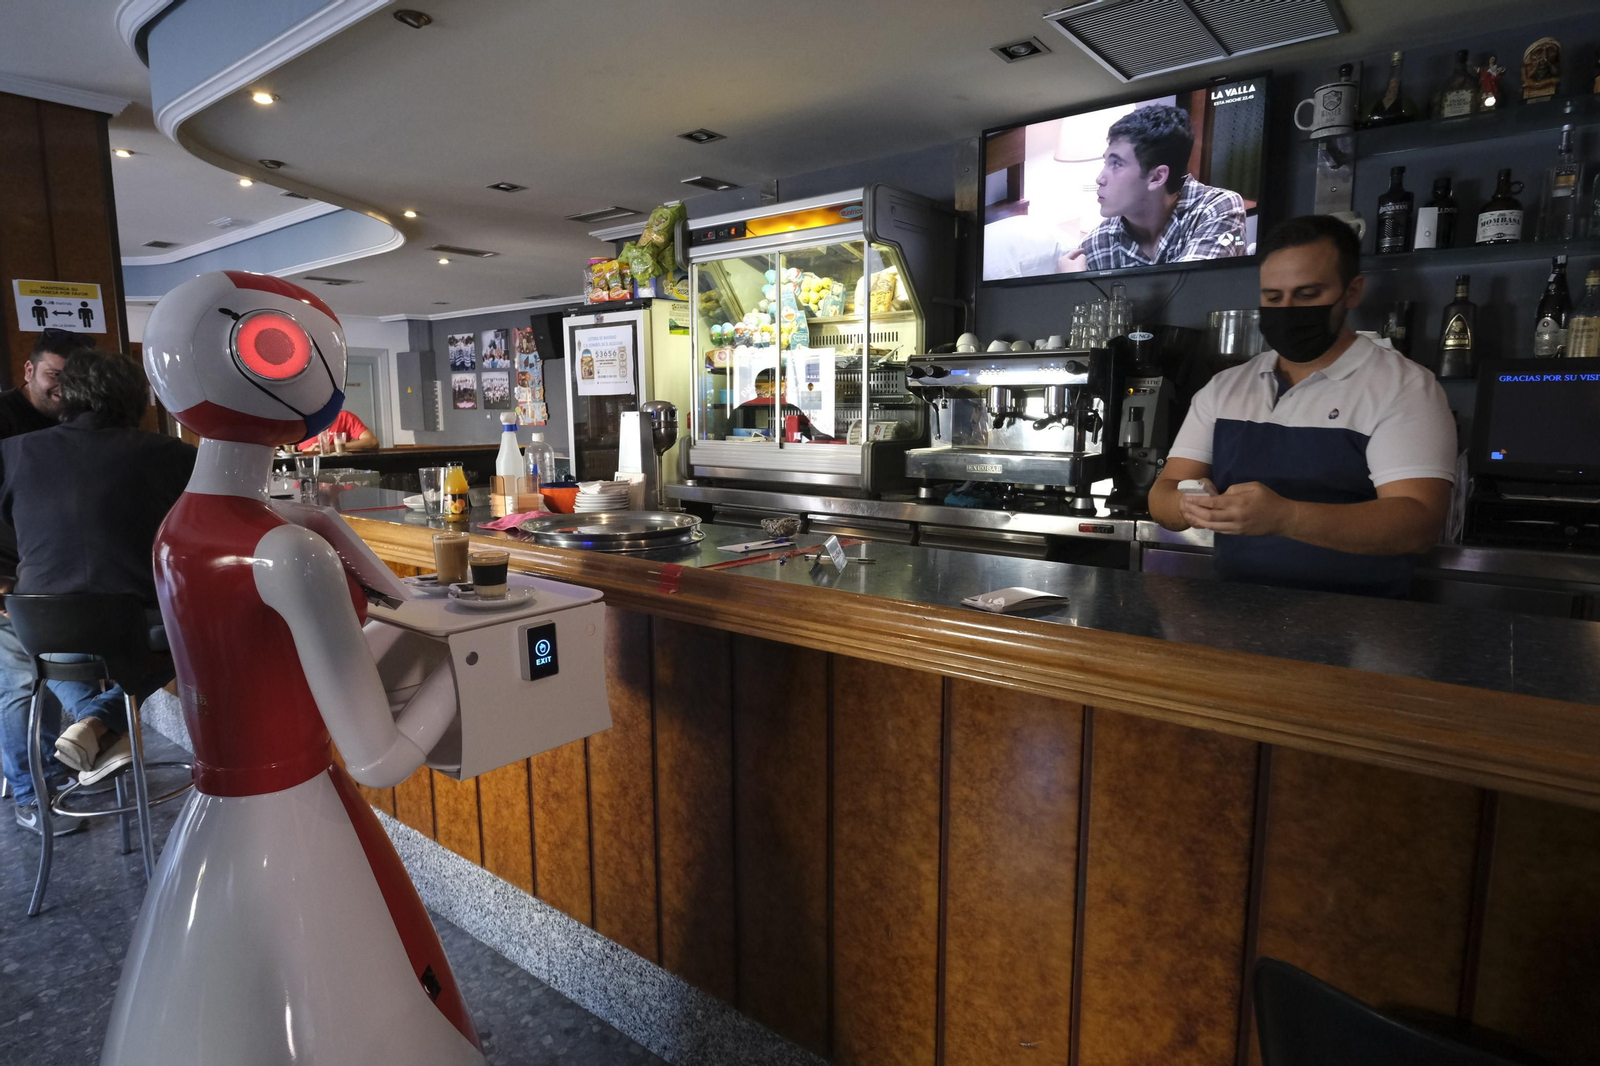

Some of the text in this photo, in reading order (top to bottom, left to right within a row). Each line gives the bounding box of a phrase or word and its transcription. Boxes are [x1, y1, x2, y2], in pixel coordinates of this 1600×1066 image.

[1211, 84, 1256, 100] LA VALLA
[595, 350, 617, 358] 53656
[536, 655, 552, 666] EXIT
